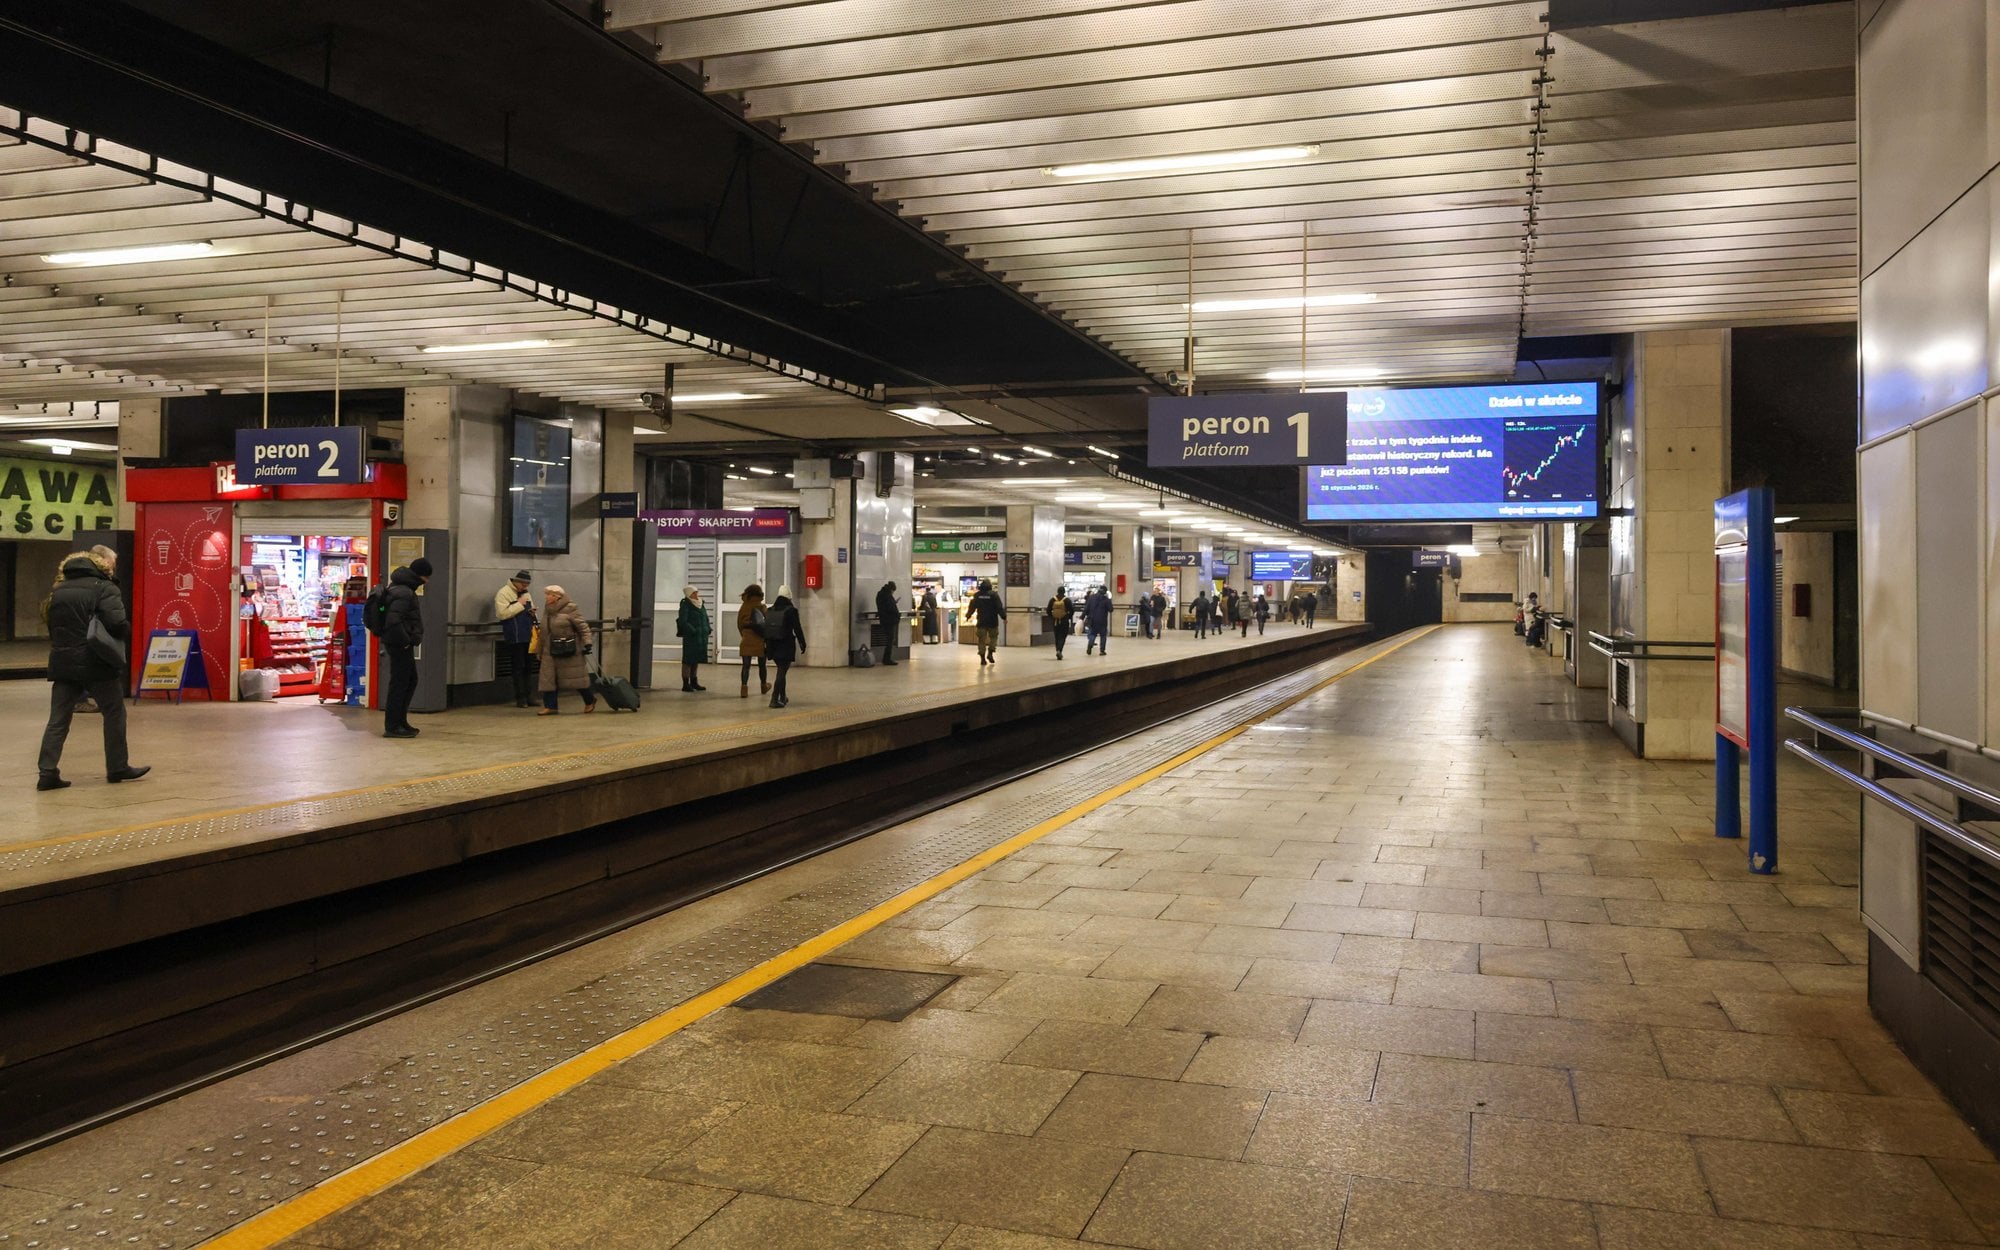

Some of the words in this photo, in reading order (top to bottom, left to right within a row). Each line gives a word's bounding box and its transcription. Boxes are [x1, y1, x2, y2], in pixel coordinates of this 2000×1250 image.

[1525, 397, 1537, 407] w
[1182, 414, 1270, 442] peron
[1287, 411, 1309, 458] 1
[1352, 437, 1377, 446] trzeci
[1389, 438, 1407, 447] tym
[1408, 436, 1449, 447] tygodniu
[1451, 434, 1483, 444] indeks
[1182, 441, 1250, 460] platform
[1387, 449, 1440, 462] historyczny
[1477, 449, 1493, 458] Ma
[255, 443, 310, 464] peron
[317, 439, 340, 477] 2
[255, 464, 297, 479] platform
[1337, 465, 1370, 477] poziom
[698, 517, 754, 527] SKARPETY
[964, 541, 998, 552] onebite
[1187, 554, 1196, 566] 2
[1444, 554, 1451, 565] 1
